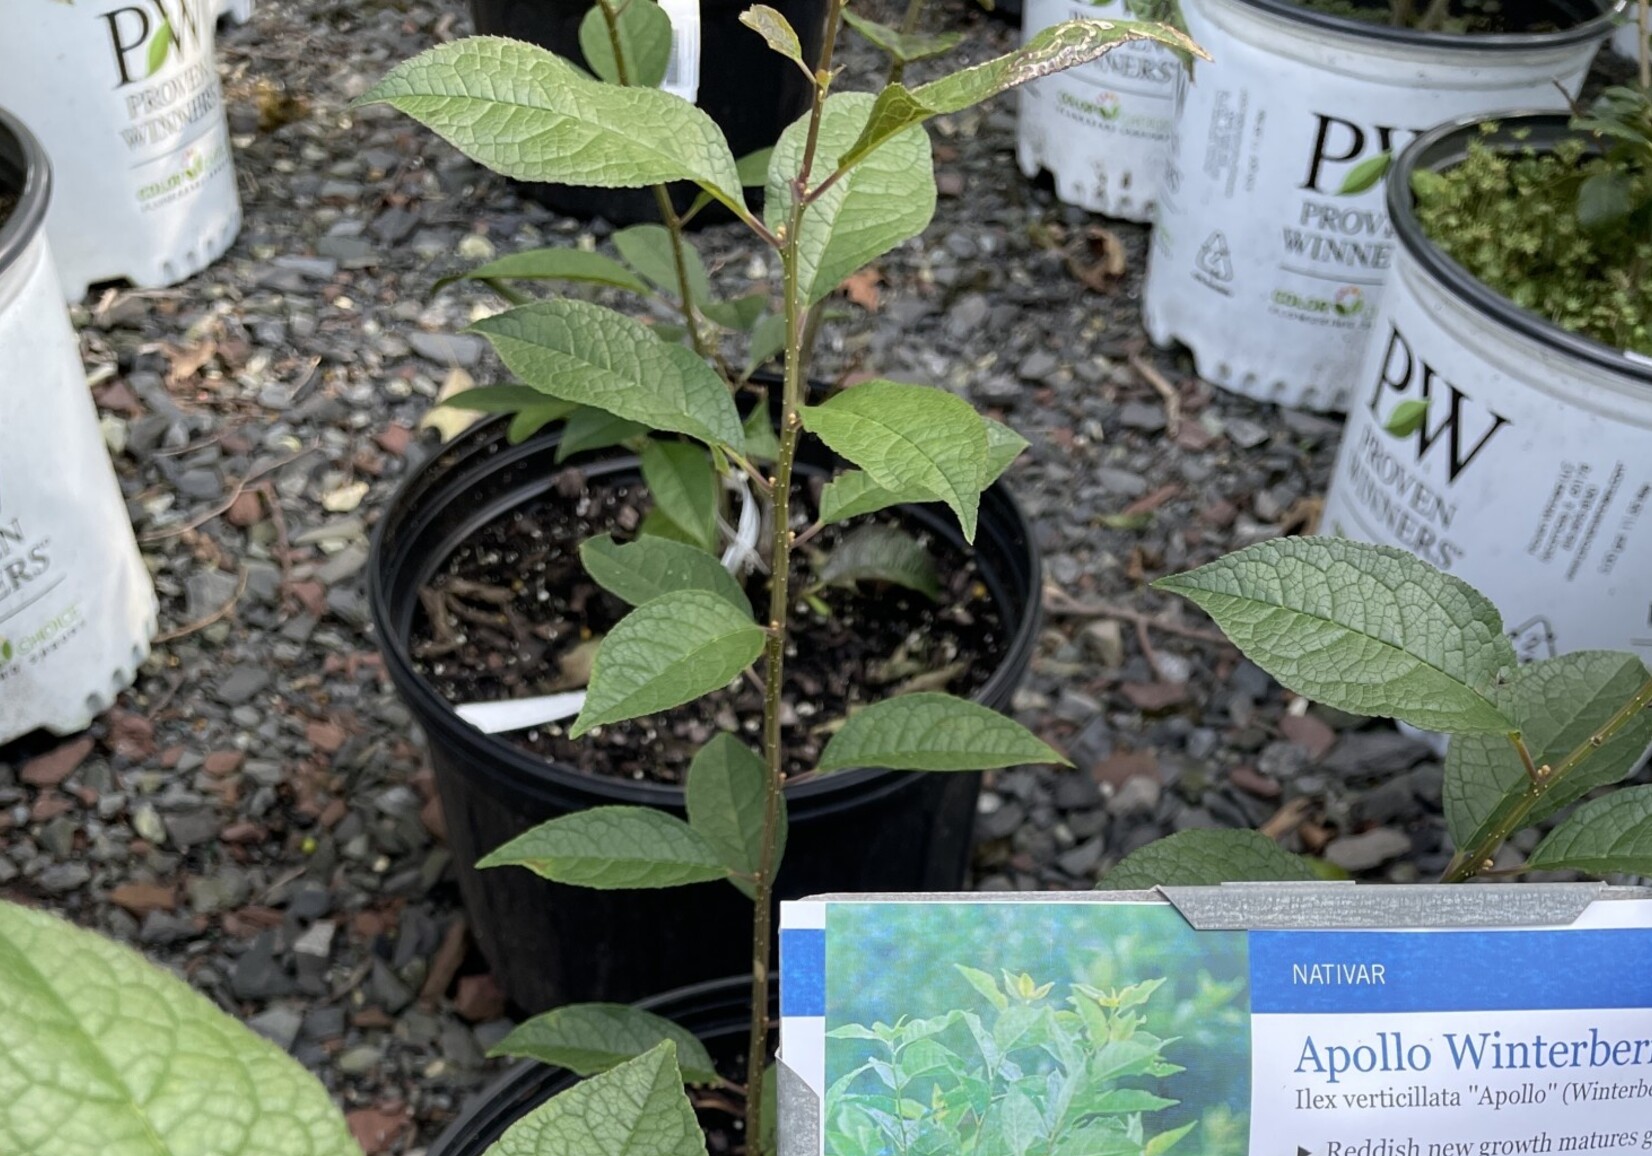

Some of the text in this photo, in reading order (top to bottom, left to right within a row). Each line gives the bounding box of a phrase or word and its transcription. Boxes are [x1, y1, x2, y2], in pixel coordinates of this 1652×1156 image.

[1281, 226, 1396, 270] WINNE
[1364, 318, 1513, 486] PW
[1360, 423, 1457, 530] PROVEN
[1292, 963, 1386, 986] NATIVAR
[1294, 1028, 1652, 1084] Apollo Winterber
[1294, 1088, 1337, 1110] Ilex
[1342, 1087, 1462, 1109] verticillata
[1468, 1083, 1557, 1110] "Apollo"
[1557, 1131, 1638, 1152] matures
